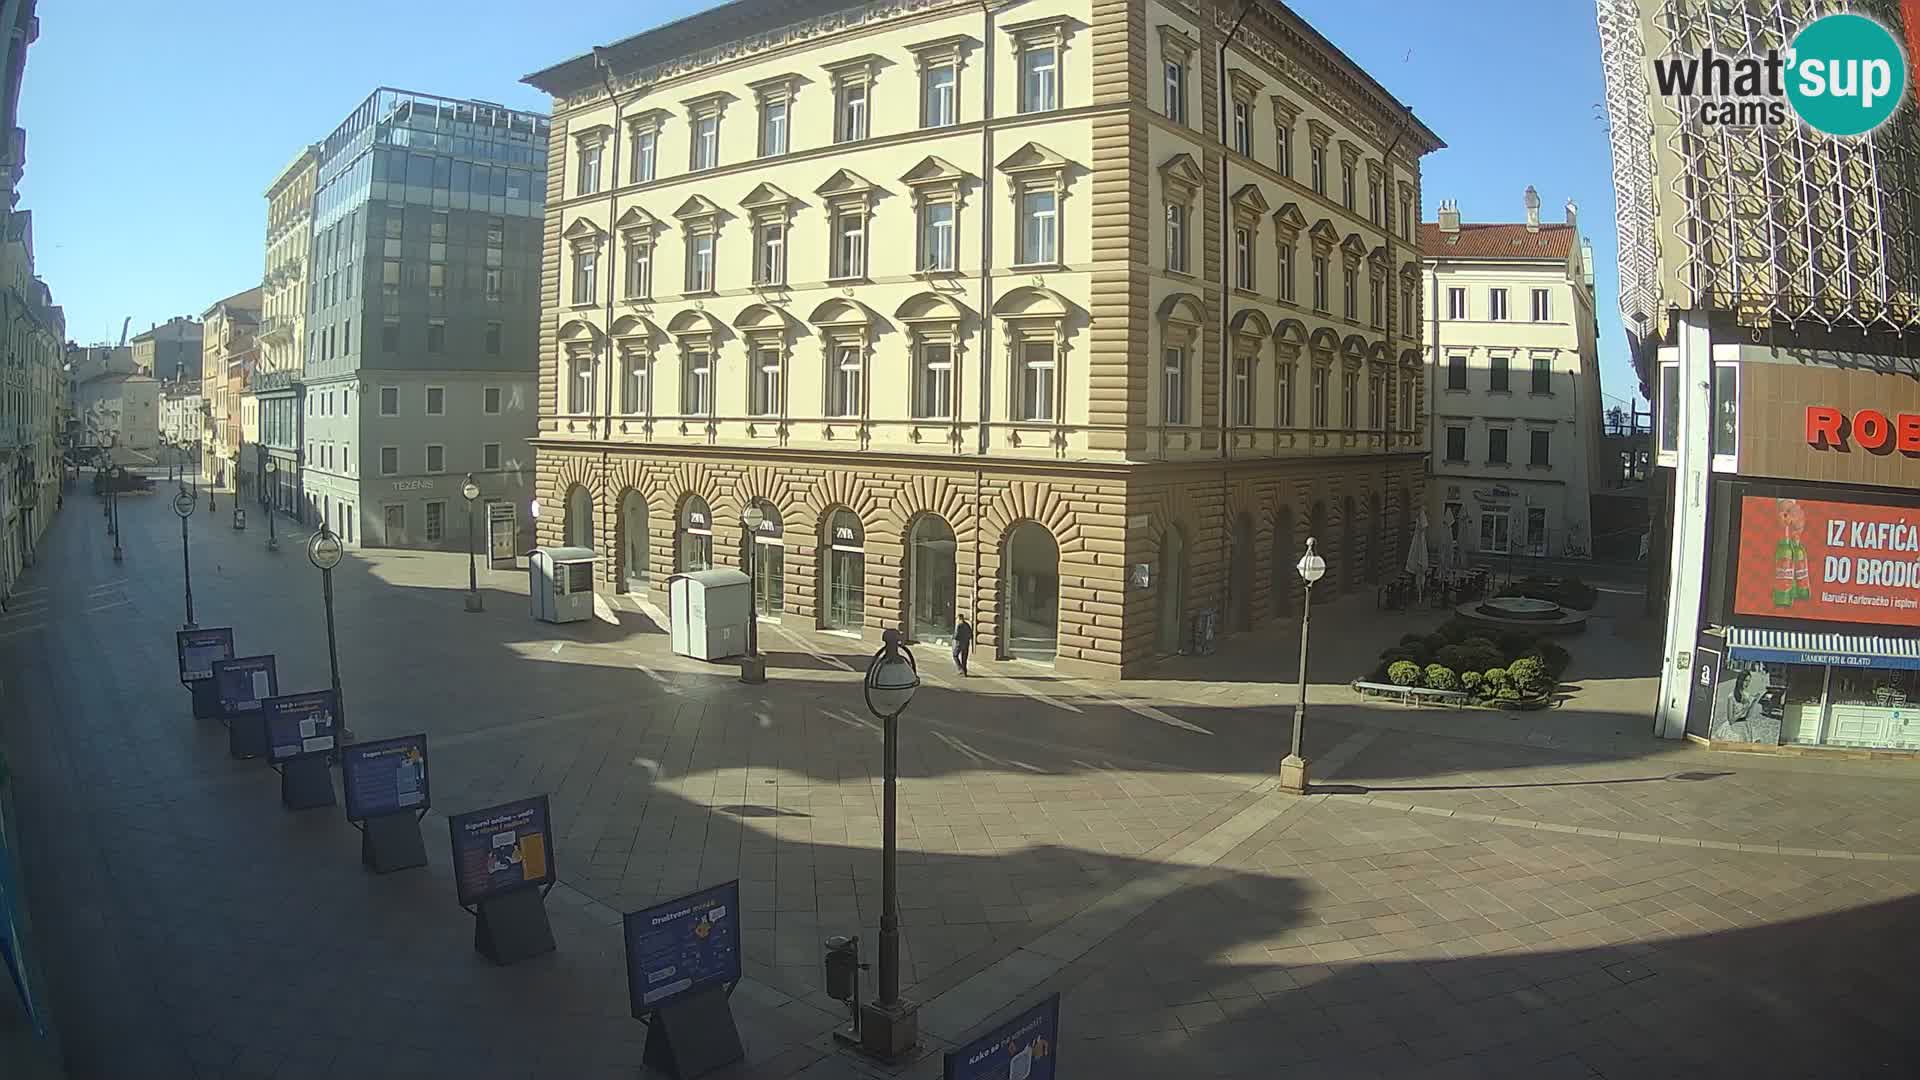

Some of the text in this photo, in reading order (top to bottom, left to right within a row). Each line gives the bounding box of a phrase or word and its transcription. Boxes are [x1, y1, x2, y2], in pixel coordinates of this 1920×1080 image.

[1827, 518, 1919, 552] IZ KAFIĆA
[1824, 556, 1851, 583] DO
[1848, 593, 1889, 607] Karlovačko
[1847, 657, 1871, 666] GELATO
